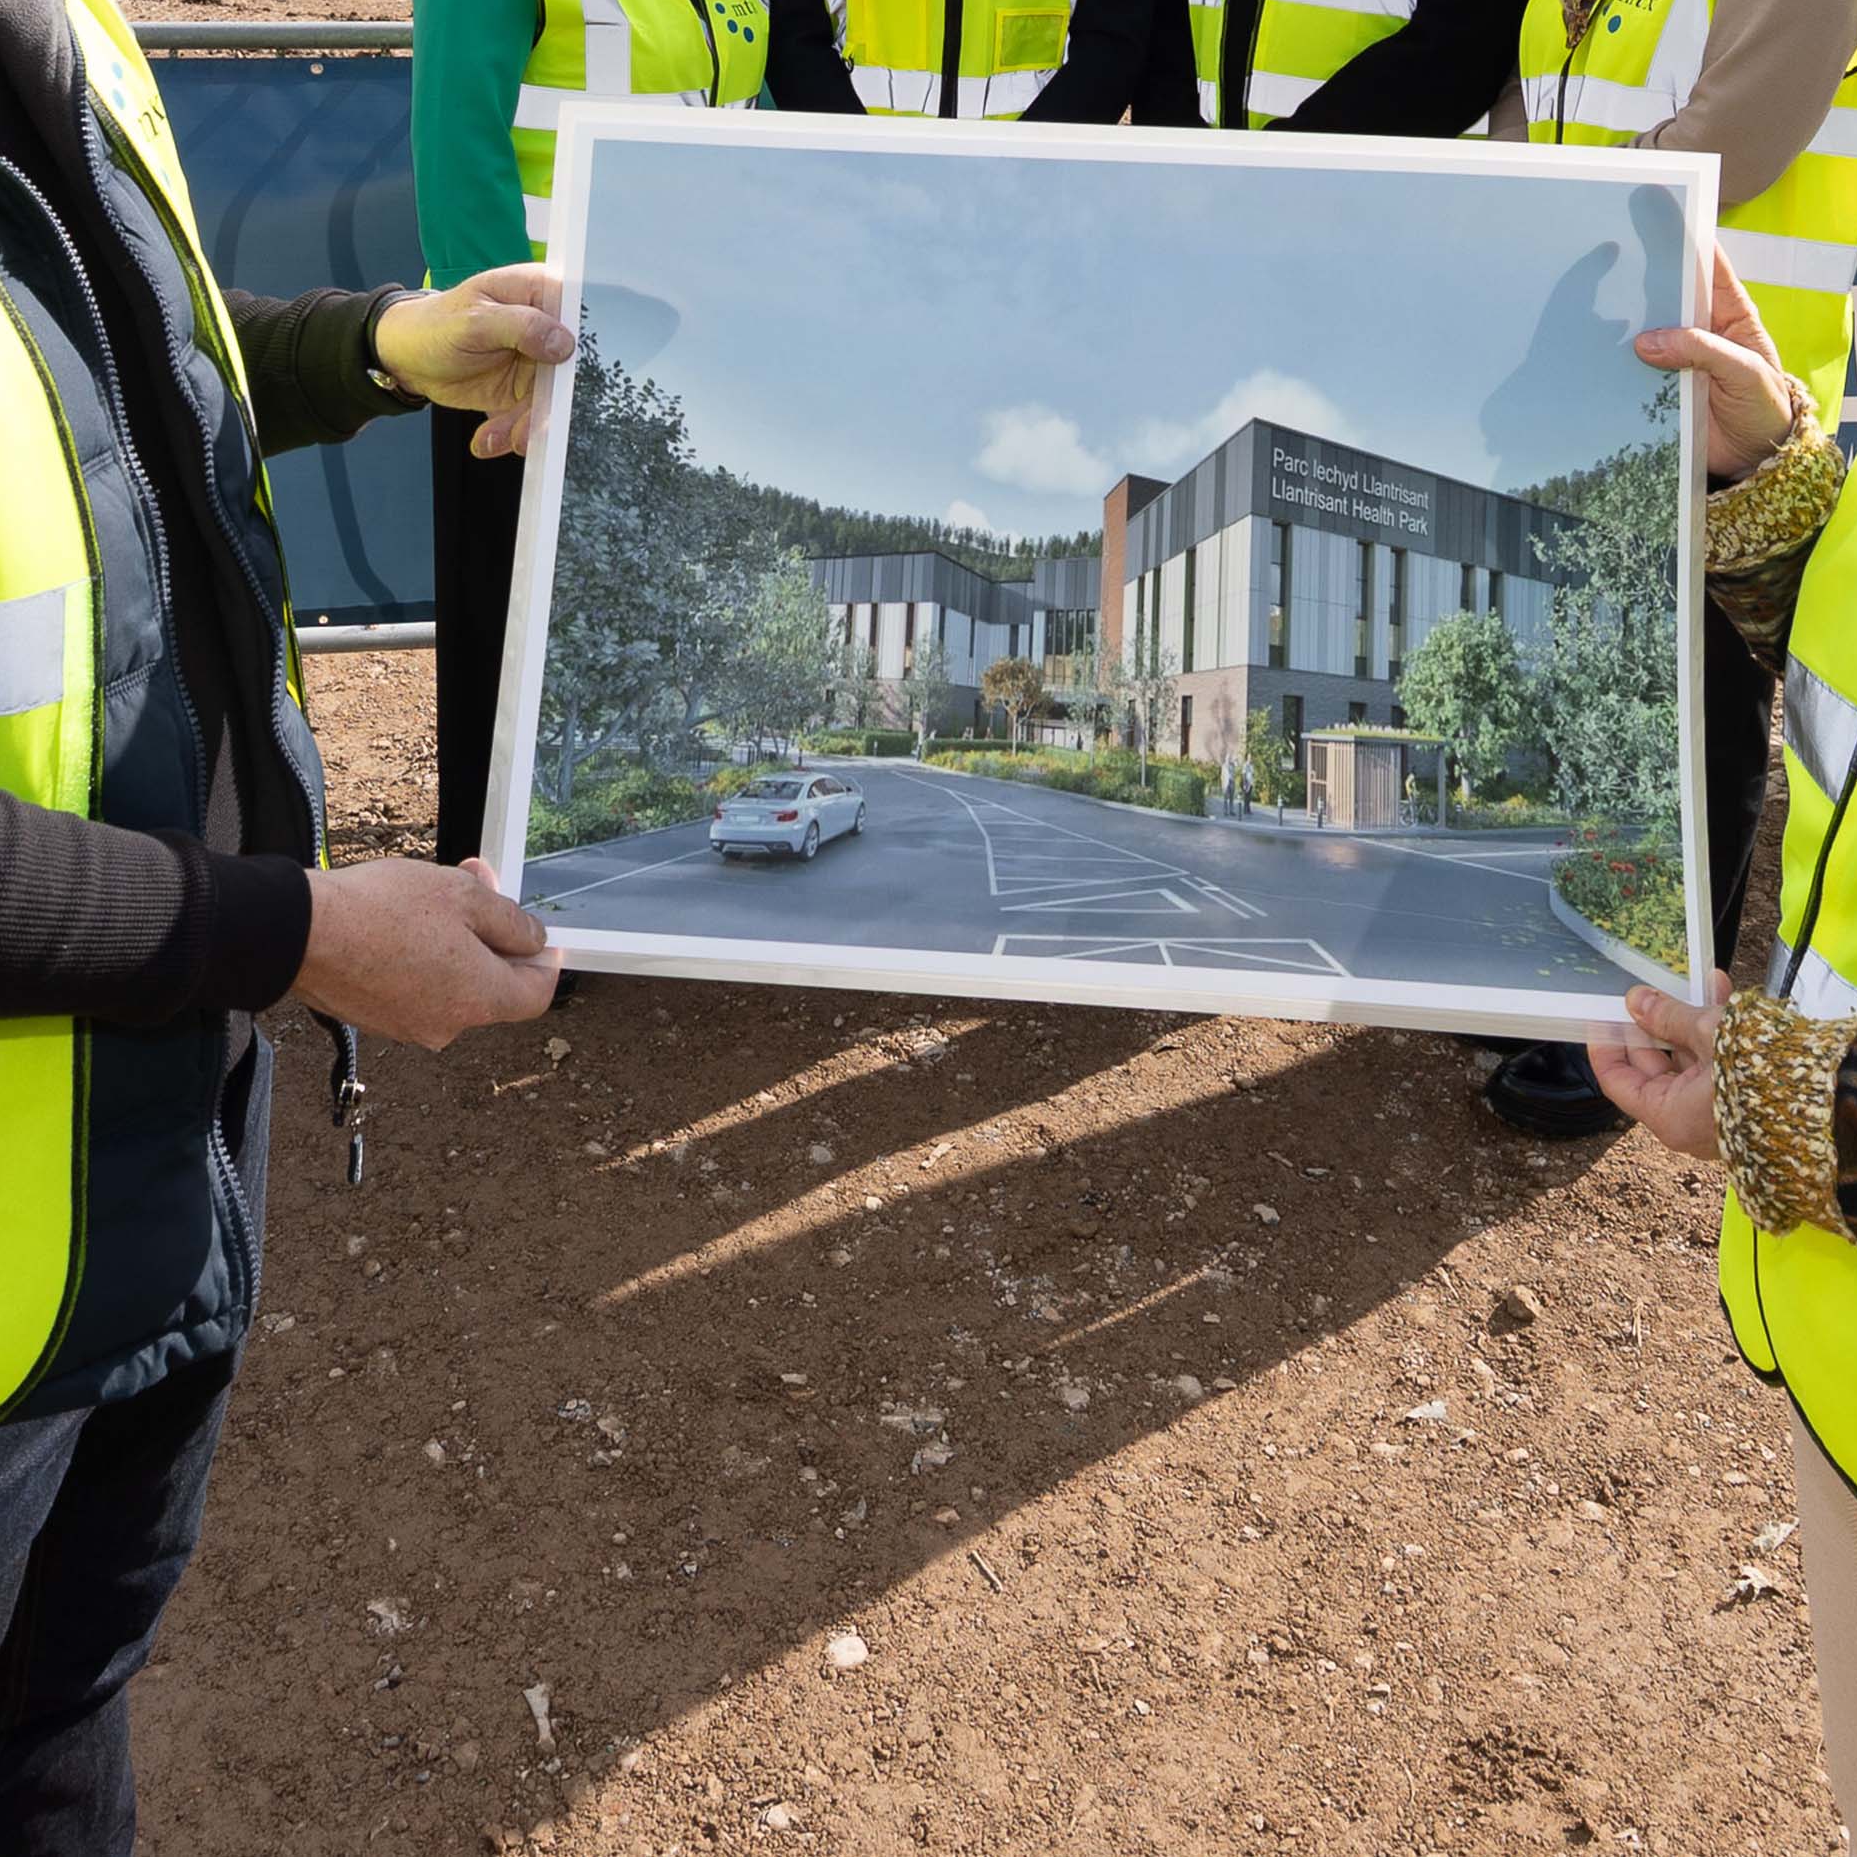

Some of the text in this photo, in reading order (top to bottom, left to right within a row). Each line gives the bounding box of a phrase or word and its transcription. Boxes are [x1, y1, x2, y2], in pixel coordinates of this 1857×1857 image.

[1272, 477, 1428, 535] Llantrisant Health Park
[1273, 447, 1429, 510] Parc Iechyd Llantrisant
